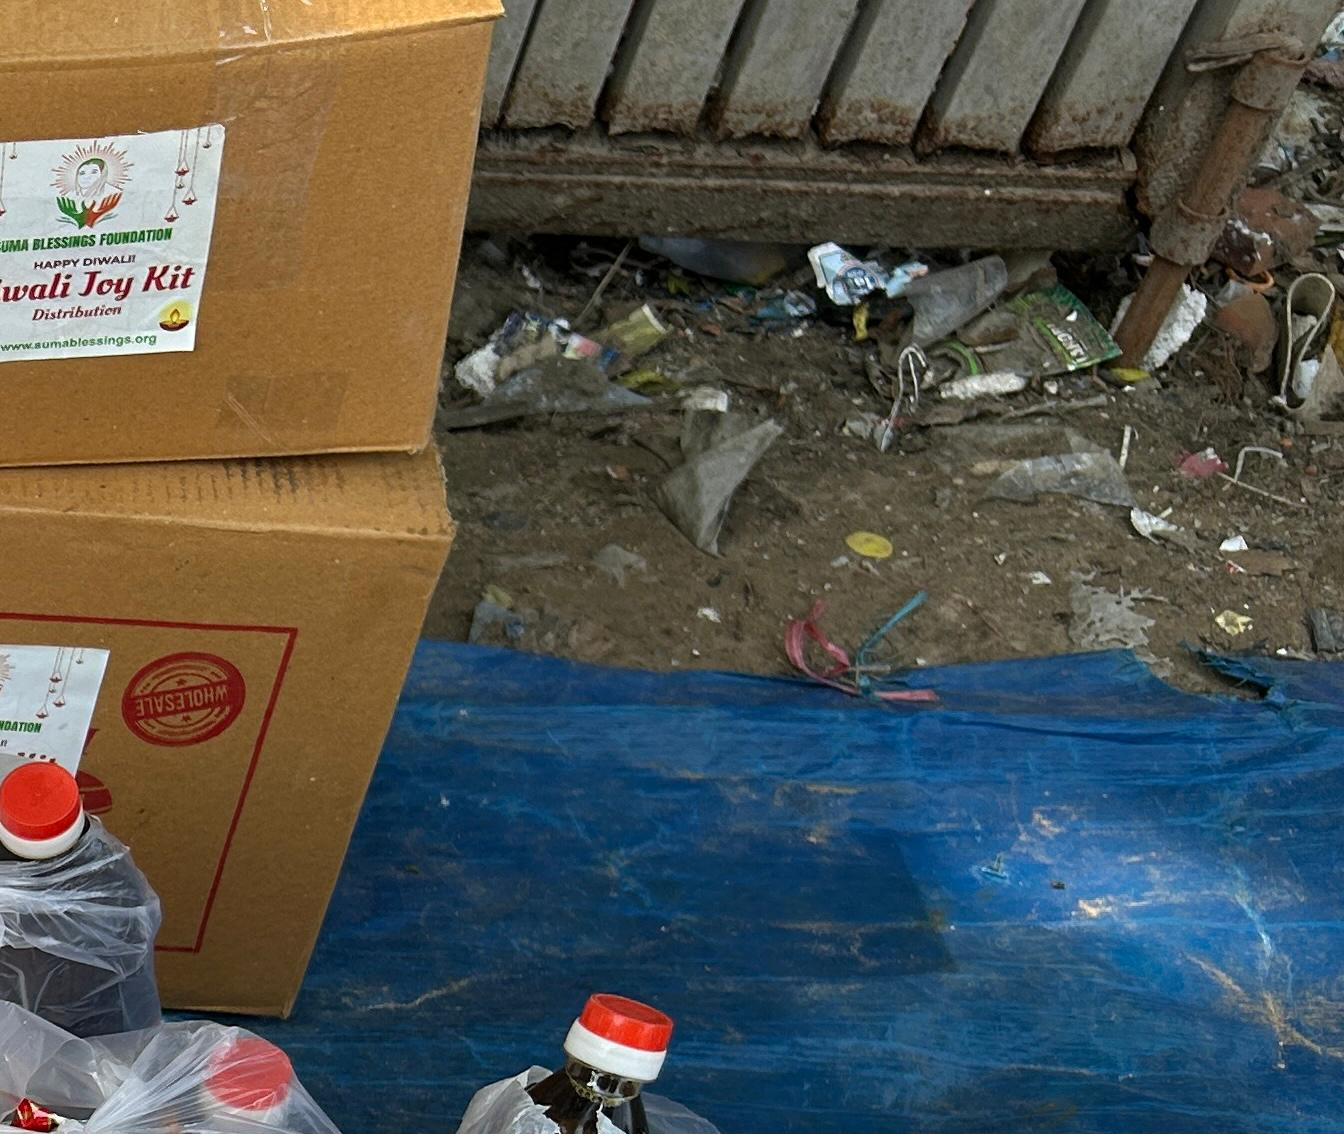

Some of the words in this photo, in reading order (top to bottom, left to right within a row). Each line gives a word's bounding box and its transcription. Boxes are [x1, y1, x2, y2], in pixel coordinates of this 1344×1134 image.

[32, 234, 96, 251] BLESSINGS
[99, 227, 173, 246] FOUNDATION
[34, 259, 80, 270] HAPPY
[83, 254, 136, 266] DIWALI!
[78, 270, 134, 301] Joy
[142, 265, 195, 292] Kit
[32, 305, 122, 320] Distribution
[0, 336, 156, 351] www.sumablessings.org
[135, 685, 228, 717] WHOLESALE
